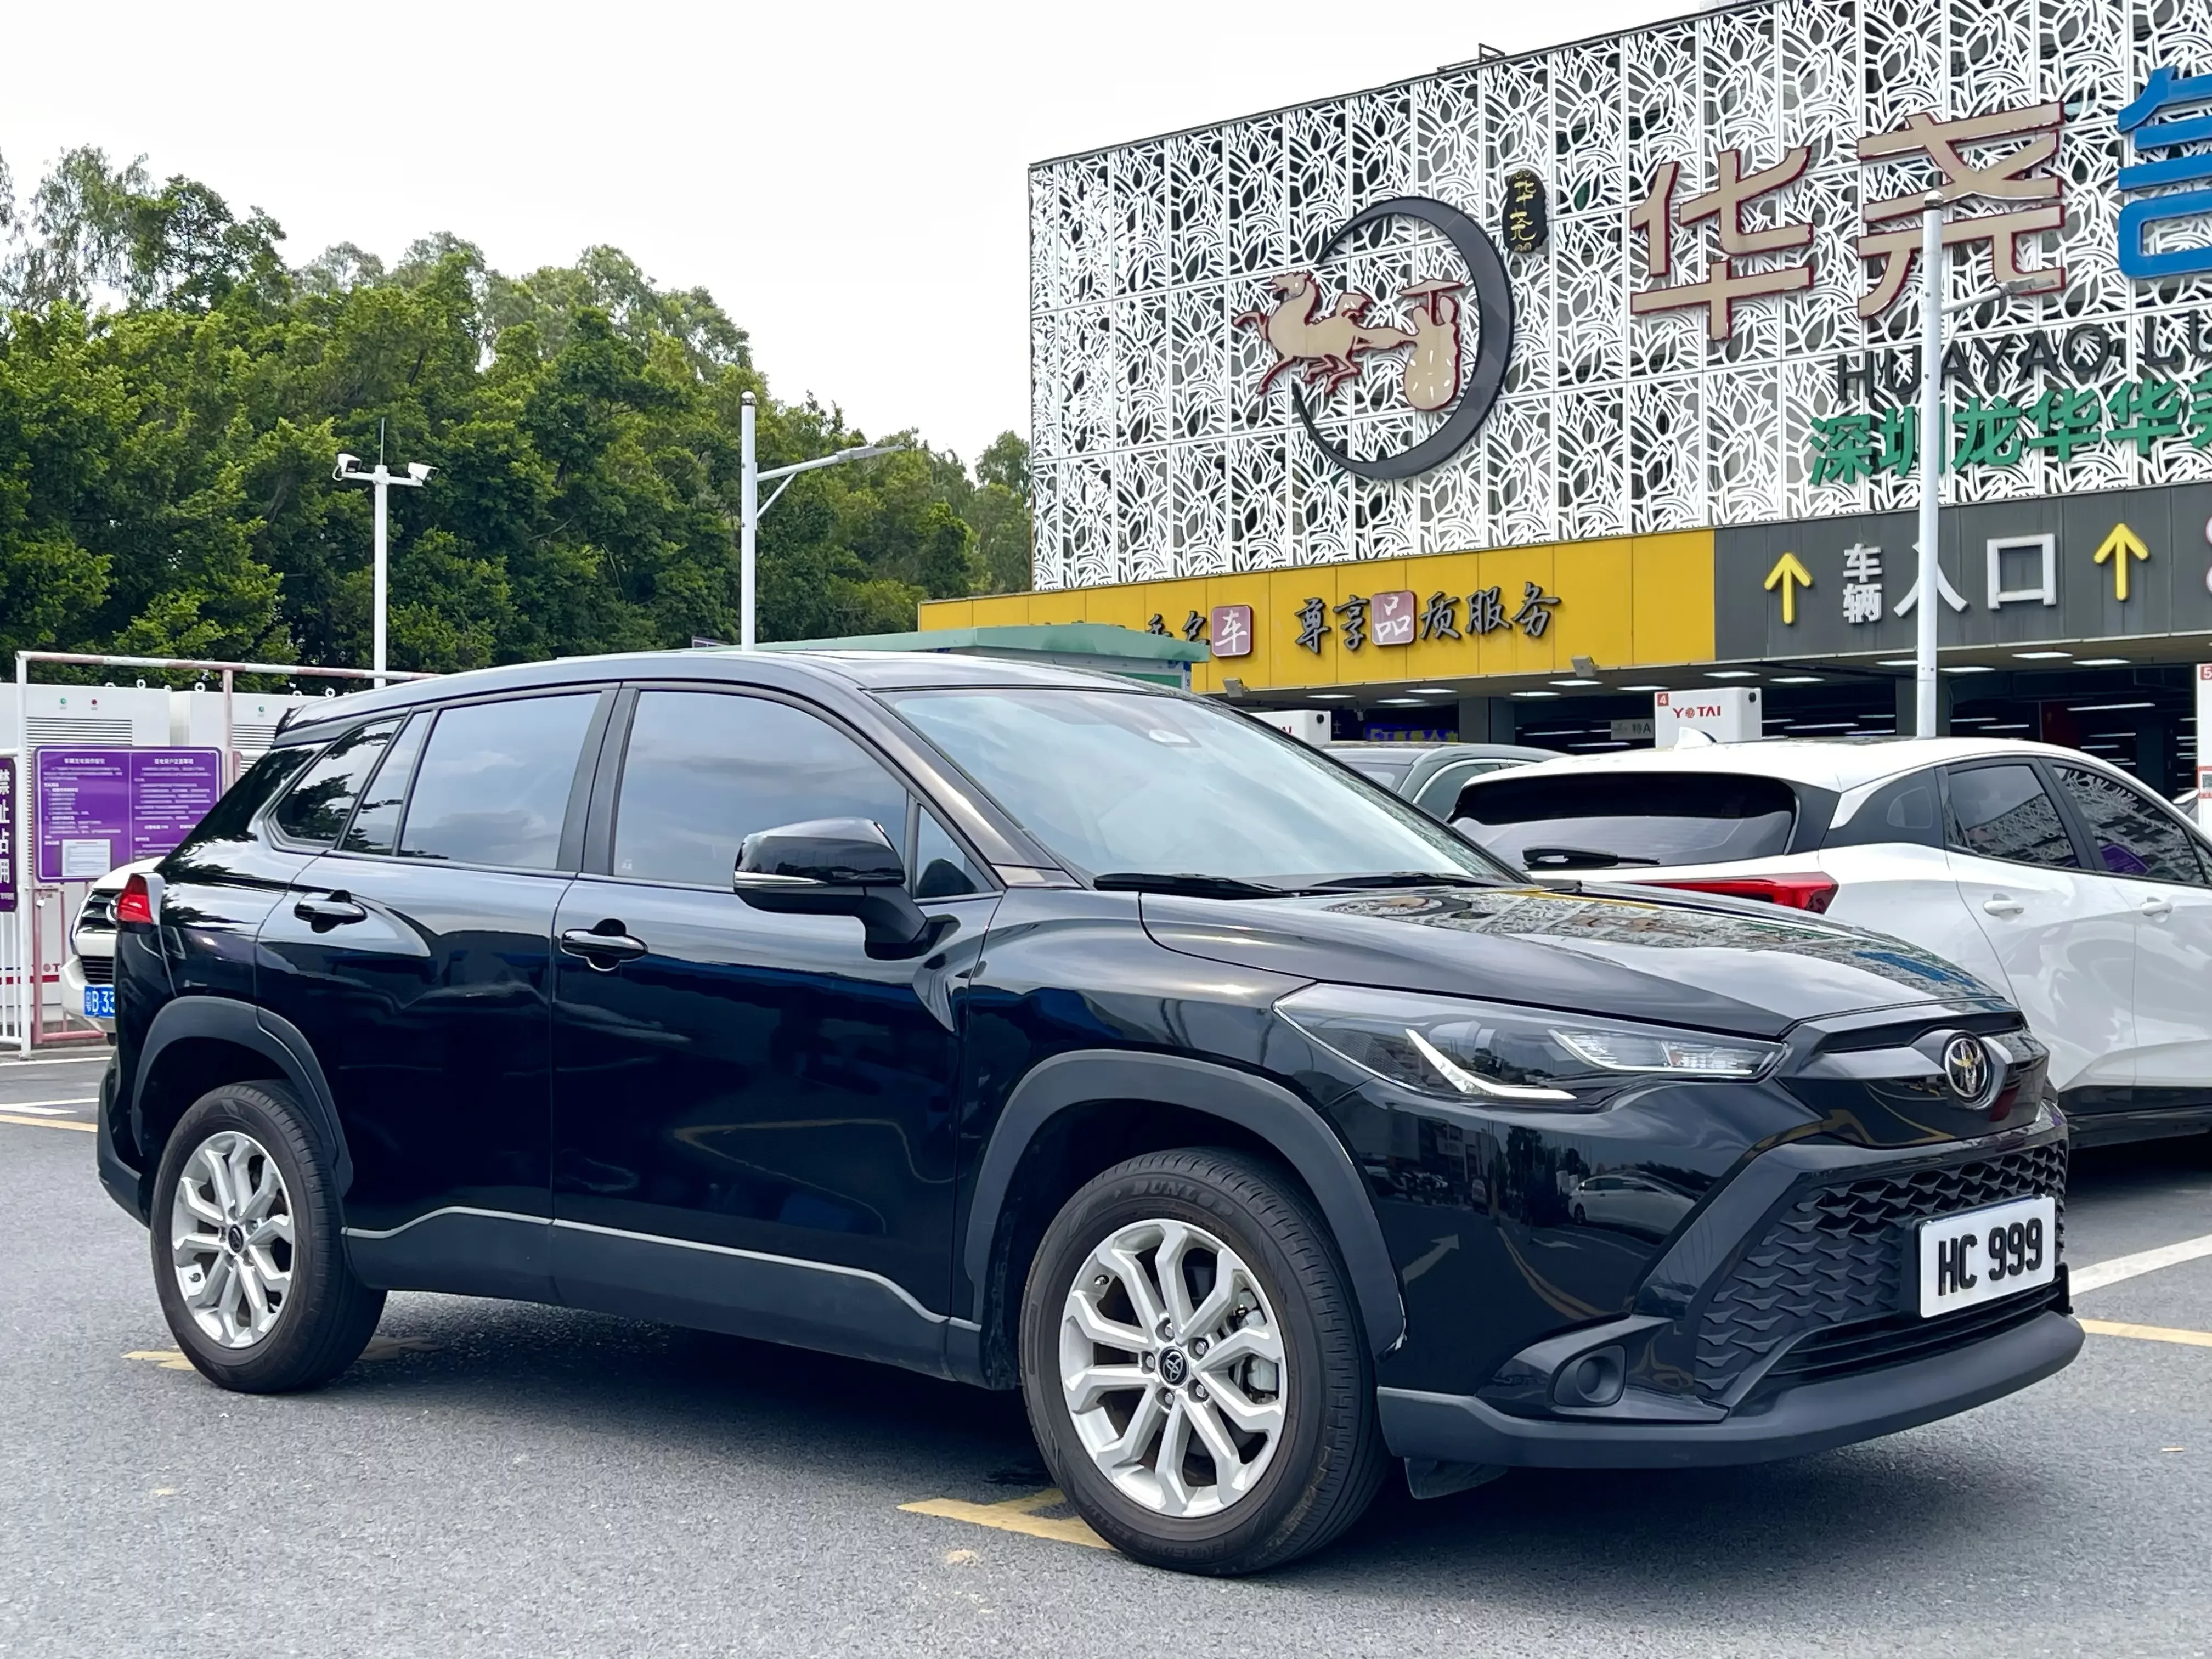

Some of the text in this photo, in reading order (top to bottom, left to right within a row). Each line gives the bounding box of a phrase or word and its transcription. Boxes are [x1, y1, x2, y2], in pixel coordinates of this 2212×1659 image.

[1838, 323, 2111, 402] HUAYAO
[1294, 582, 1562, 655] 尊享品质服务
[1131, 1180, 1234, 1216] DUNLOP
[1938, 1217, 2043, 1296] HC 999
